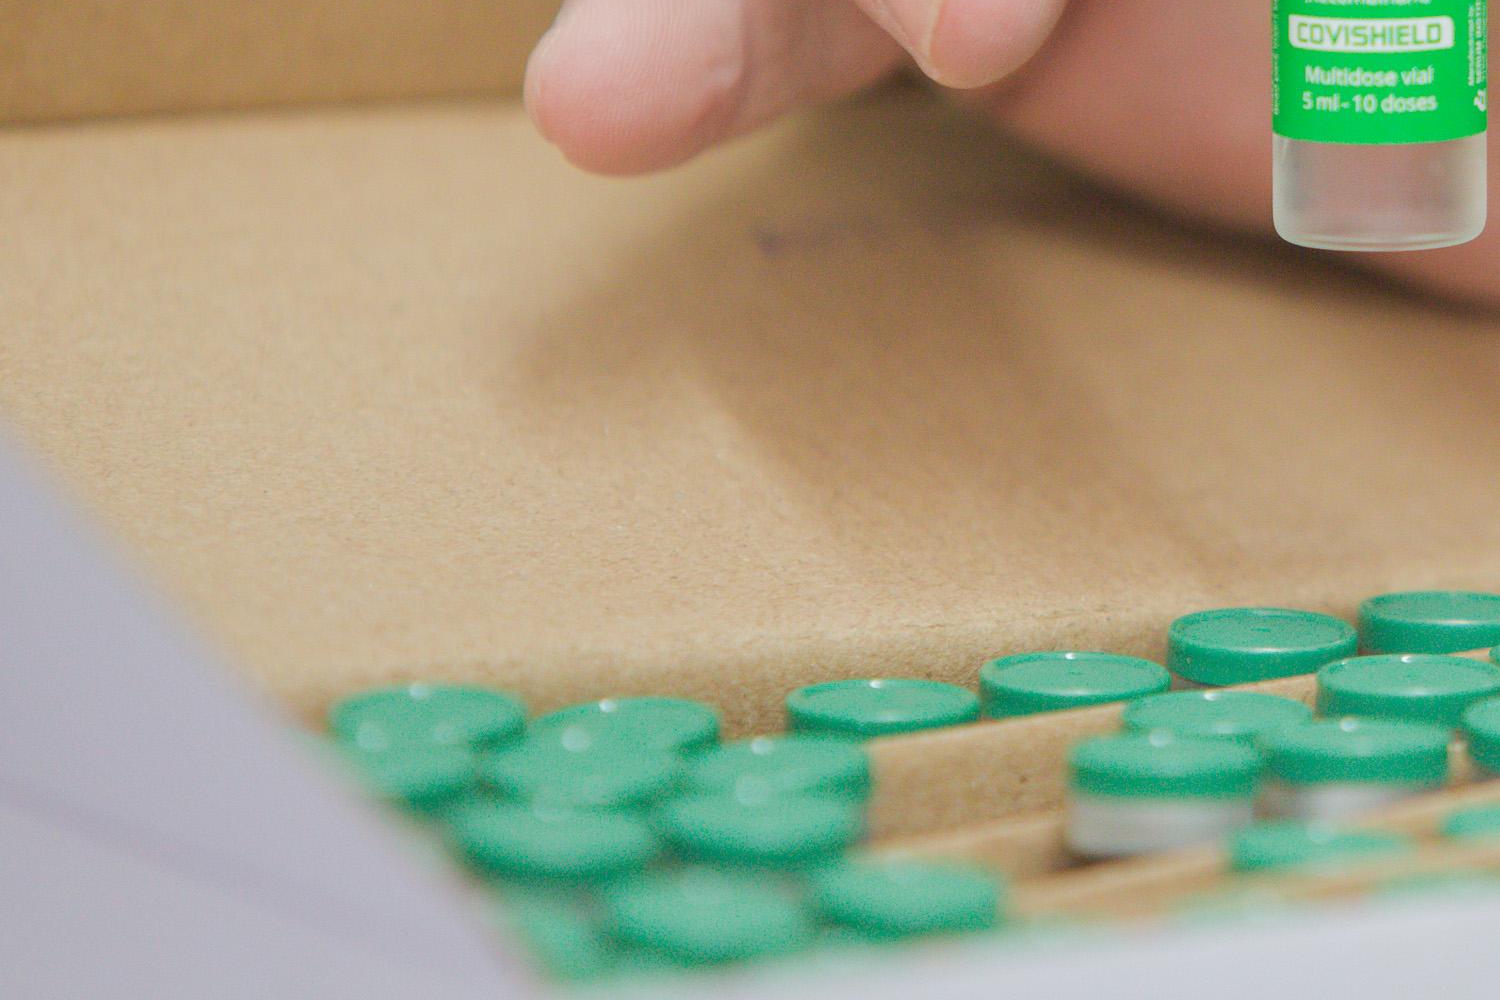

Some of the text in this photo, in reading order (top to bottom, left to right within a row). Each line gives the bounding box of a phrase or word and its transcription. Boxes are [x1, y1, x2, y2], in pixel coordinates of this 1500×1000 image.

[1297, 22, 1442, 46] COVISHIELD
[1304, 64, 1435, 87] Multidose vial
[1352, 93, 1378, 113] 10
[1380, 93, 1438, 113] doses
